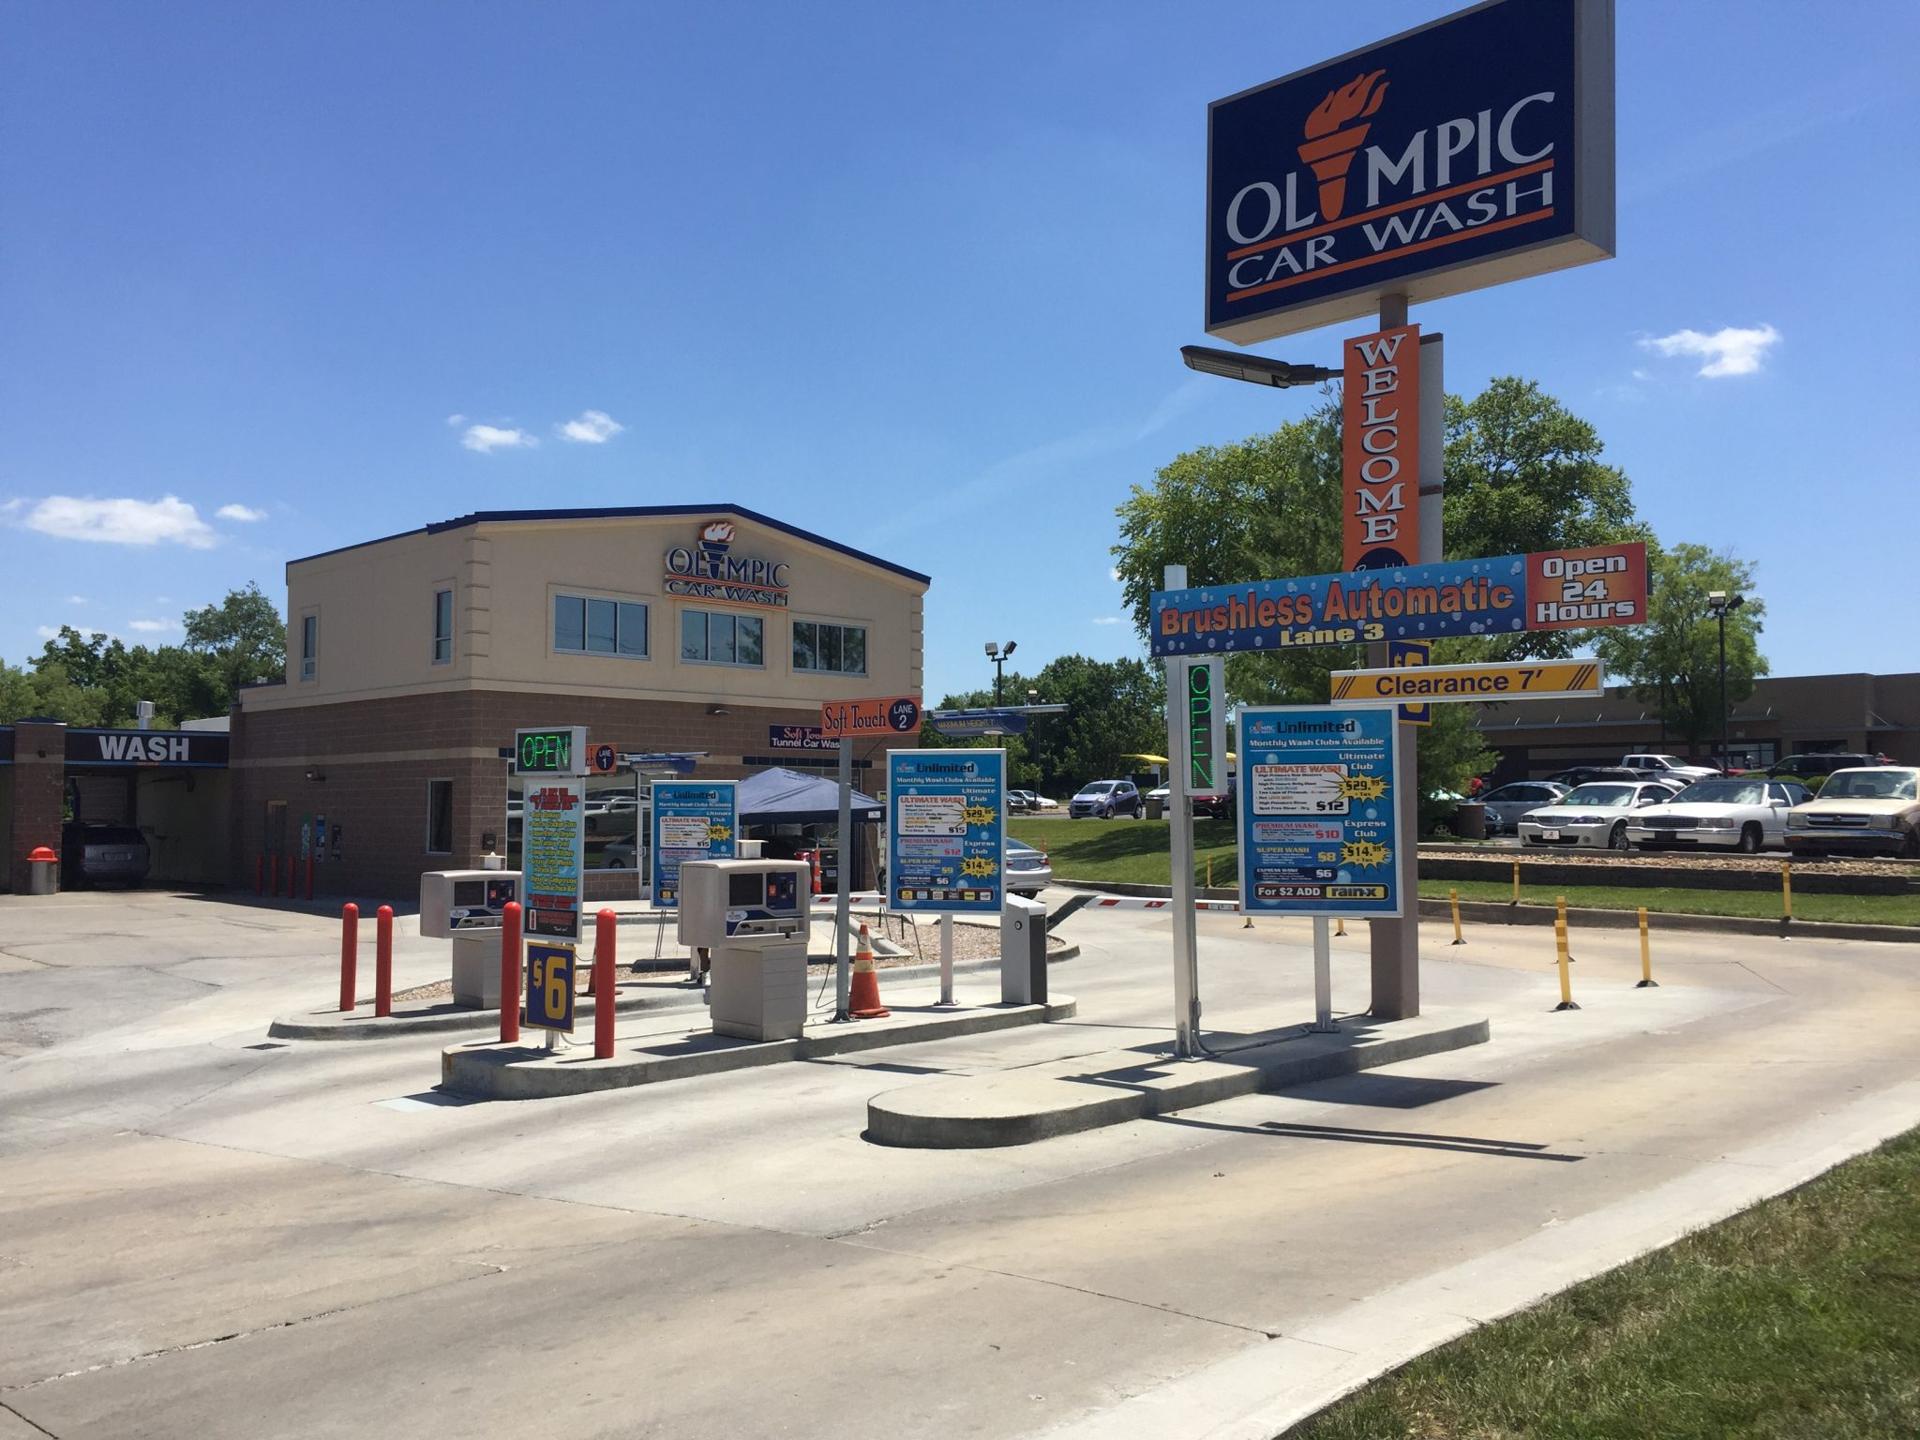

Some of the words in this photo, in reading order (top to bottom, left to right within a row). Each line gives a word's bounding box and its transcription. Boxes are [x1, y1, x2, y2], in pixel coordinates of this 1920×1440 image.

[1227, 234, 1338, 290] CAR
[1362, 171, 1553, 252] WASH
[1354, 333, 1408, 546] WELCOME
[1543, 554, 1628, 581] Open
[667, 580, 717, 598] CAR
[722, 586, 788, 607] WASH
[1562, 579, 1608, 603] 24
[1161, 591, 1313, 636] Brushless
[1323, 577, 1514, 623] Automatic
[1536, 600, 1636, 623] Hours
[1280, 628, 1356, 646] Lane
[1363, 623, 1385, 641] 3
[1376, 674, 1510, 696] Clearance
[1518, 669, 1544, 690] 7'
[824, 706, 848, 737] Soft
[851, 703, 886, 729] Touch
[893, 704, 913, 715] LANE
[899, 715, 907, 729] 2
[1190, 666, 1215, 788] OPEN
[1276, 720, 1355, 734] Unlimited
[98, 735, 190, 762] WASH
[522, 735, 569, 767] OPEN
[771, 737, 801, 748] Tunnel
[803, 739, 820, 748] Car
[821, 739, 841, 749] Was
[1249, 739, 1287, 748] Monthly
[1315, 738, 1340, 746] Clubs
[1342, 738, 1385, 746] Available
[916, 763, 975, 773] Unlimited
[1255, 765, 1307, 773] ULTIMATE
[1309, 765, 1341, 773] WASH
[1316, 800, 1344, 811] $12
[949, 826, 965, 834] $15
[1315, 830, 1339, 839] $10
[1345, 820, 1386, 828] Express
[1316, 869, 1332, 878] $6
[1258, 887, 1277, 896] For
[1279, 886, 1294, 896] $2
[1296, 887, 1321, 896] ADD
[533, 955, 567, 1020] $6
